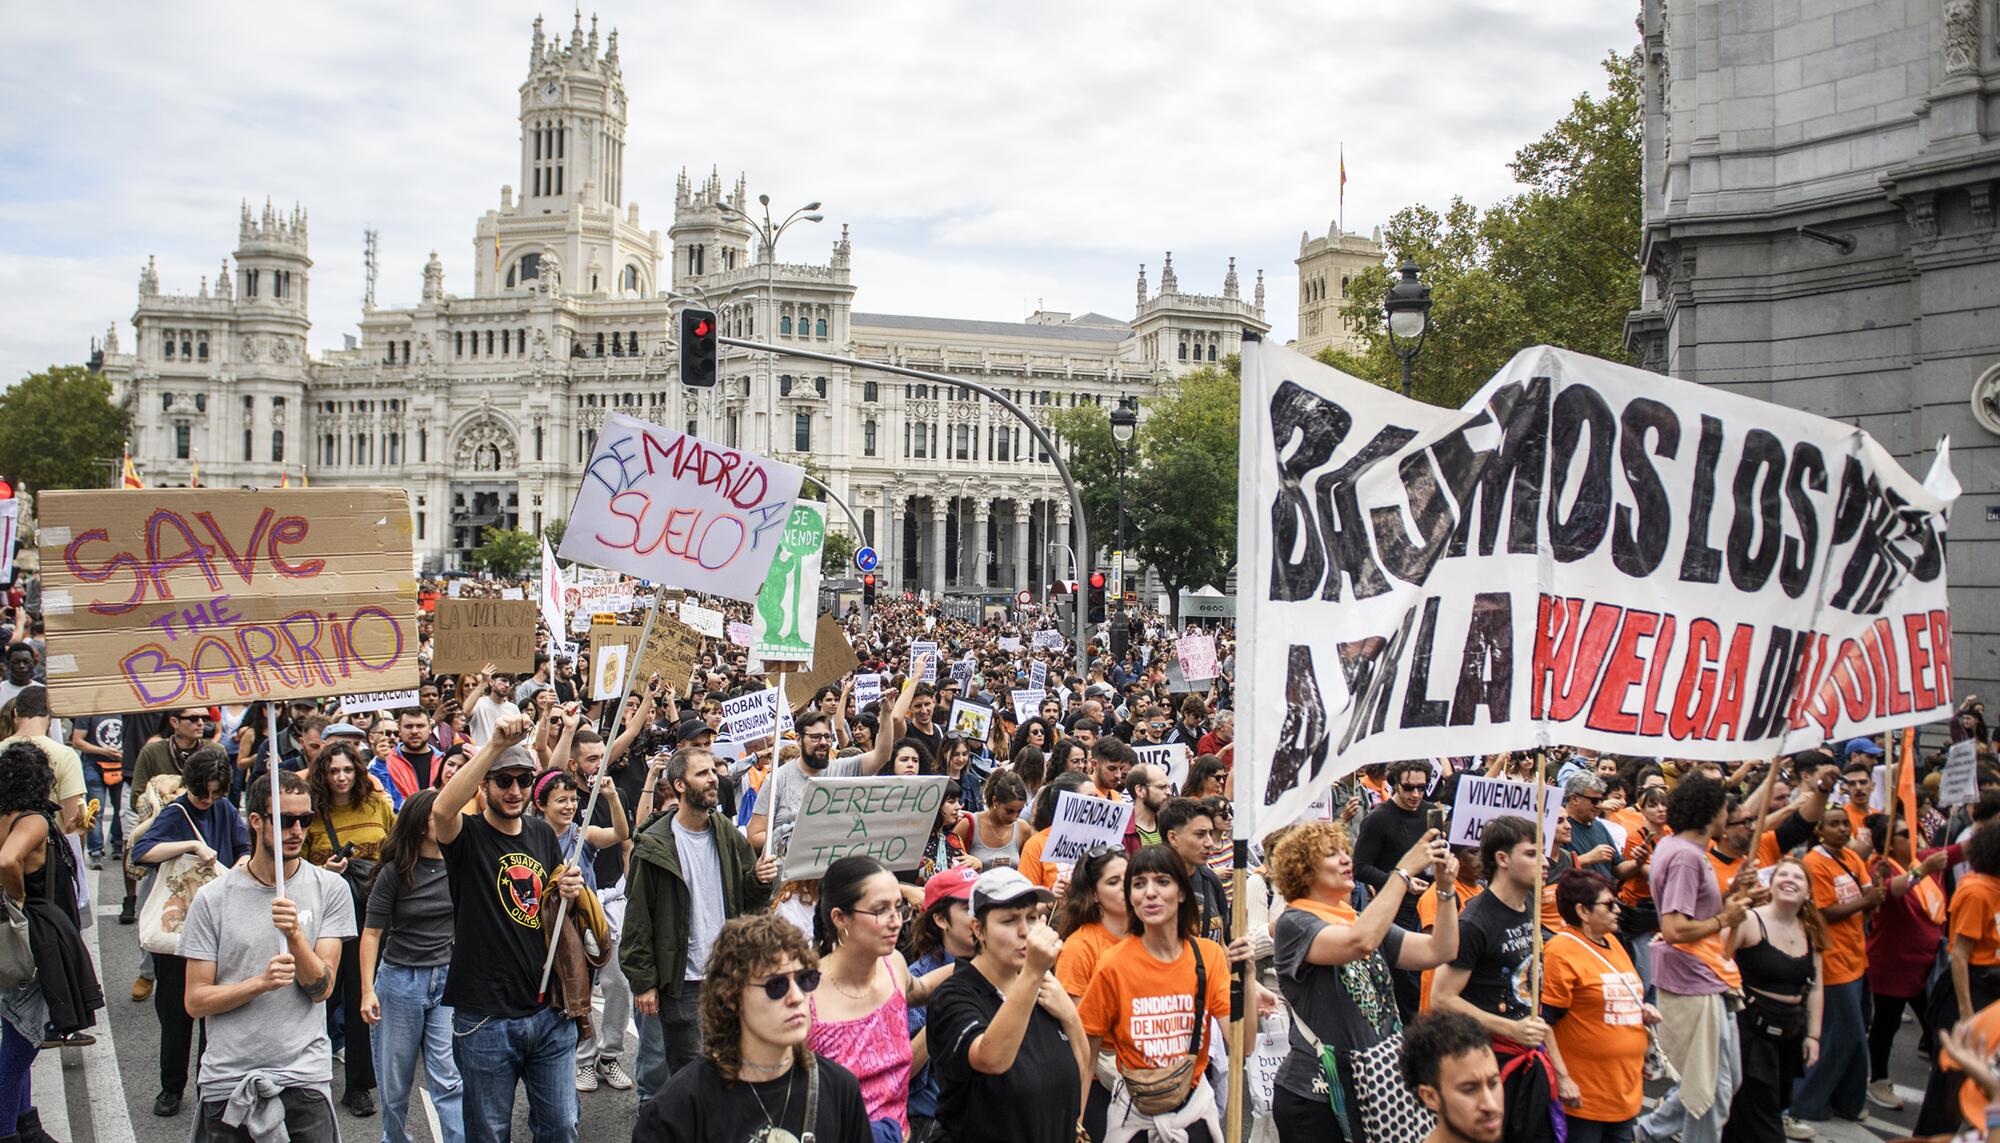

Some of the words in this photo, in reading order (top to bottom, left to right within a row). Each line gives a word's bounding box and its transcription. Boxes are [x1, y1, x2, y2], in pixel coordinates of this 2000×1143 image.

[588, 436, 648, 498] DE
[792, 509, 809, 527] SE
[1679, 413, 1829, 600] LOS
[595, 490, 747, 570] SUELO
[784, 529, 819, 547] VENDE
[151, 593, 242, 641] THE
[438, 604, 460, 630] LA
[465, 603, 533, 628] VIVIENDA
[1264, 644, 1331, 806] A
[1399, 591, 1514, 730] LA
[1530, 592, 1755, 743] HUELGA
[734, 712, 769, 735] CENSURAN
[805, 783, 941, 816] DERECHO
[1063, 796, 1110, 828] VIVIENDA
[1468, 779, 1532, 812] VIVIENDA
[1534, 789, 1550, 818] I,
[847, 818, 868, 839] A
[500, 859, 509, 870] 3
[509, 855, 544, 877] SUAVES
[1132, 993, 1194, 1016] SINDICATO
[1134, 1019, 1150, 1036] DE
